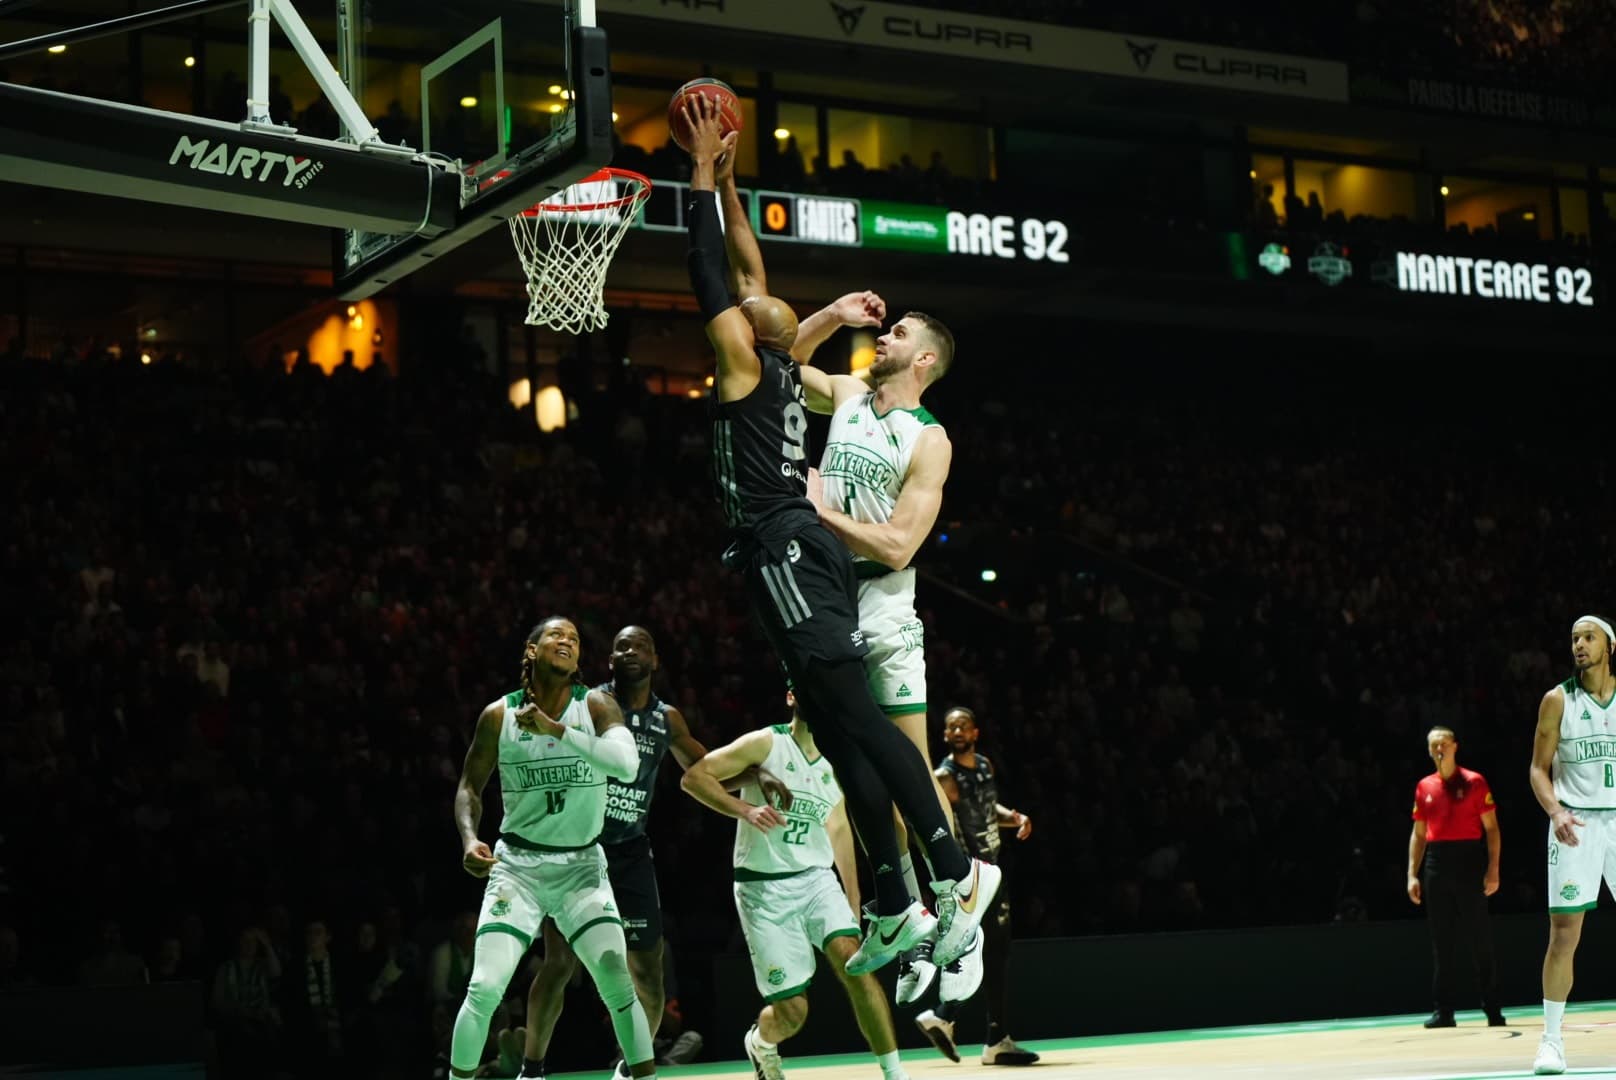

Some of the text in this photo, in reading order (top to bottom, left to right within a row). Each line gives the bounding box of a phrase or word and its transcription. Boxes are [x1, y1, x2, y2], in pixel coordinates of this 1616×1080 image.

[883, 16, 1033, 52] CUPRA
[1173, 53, 1307, 86] CUPRA
[1408, 78, 1455, 110] PARIS
[1457, 85, 1476, 112] LA
[168, 135, 311, 187] MARTY
[765, 202, 787, 231] 0
[1022, 218, 1070, 263] 92
[1396, 251, 1550, 302] NANTERRE
[1555, 268, 1594, 305] 92
[782, 401, 807, 461] 9
[787, 540, 801, 562] 9
[516, 759, 593, 789] NANTERRE92
[607, 784, 647, 802] SMART
[605, 807, 639, 823] HINGS
[783, 819, 810, 845] 22
